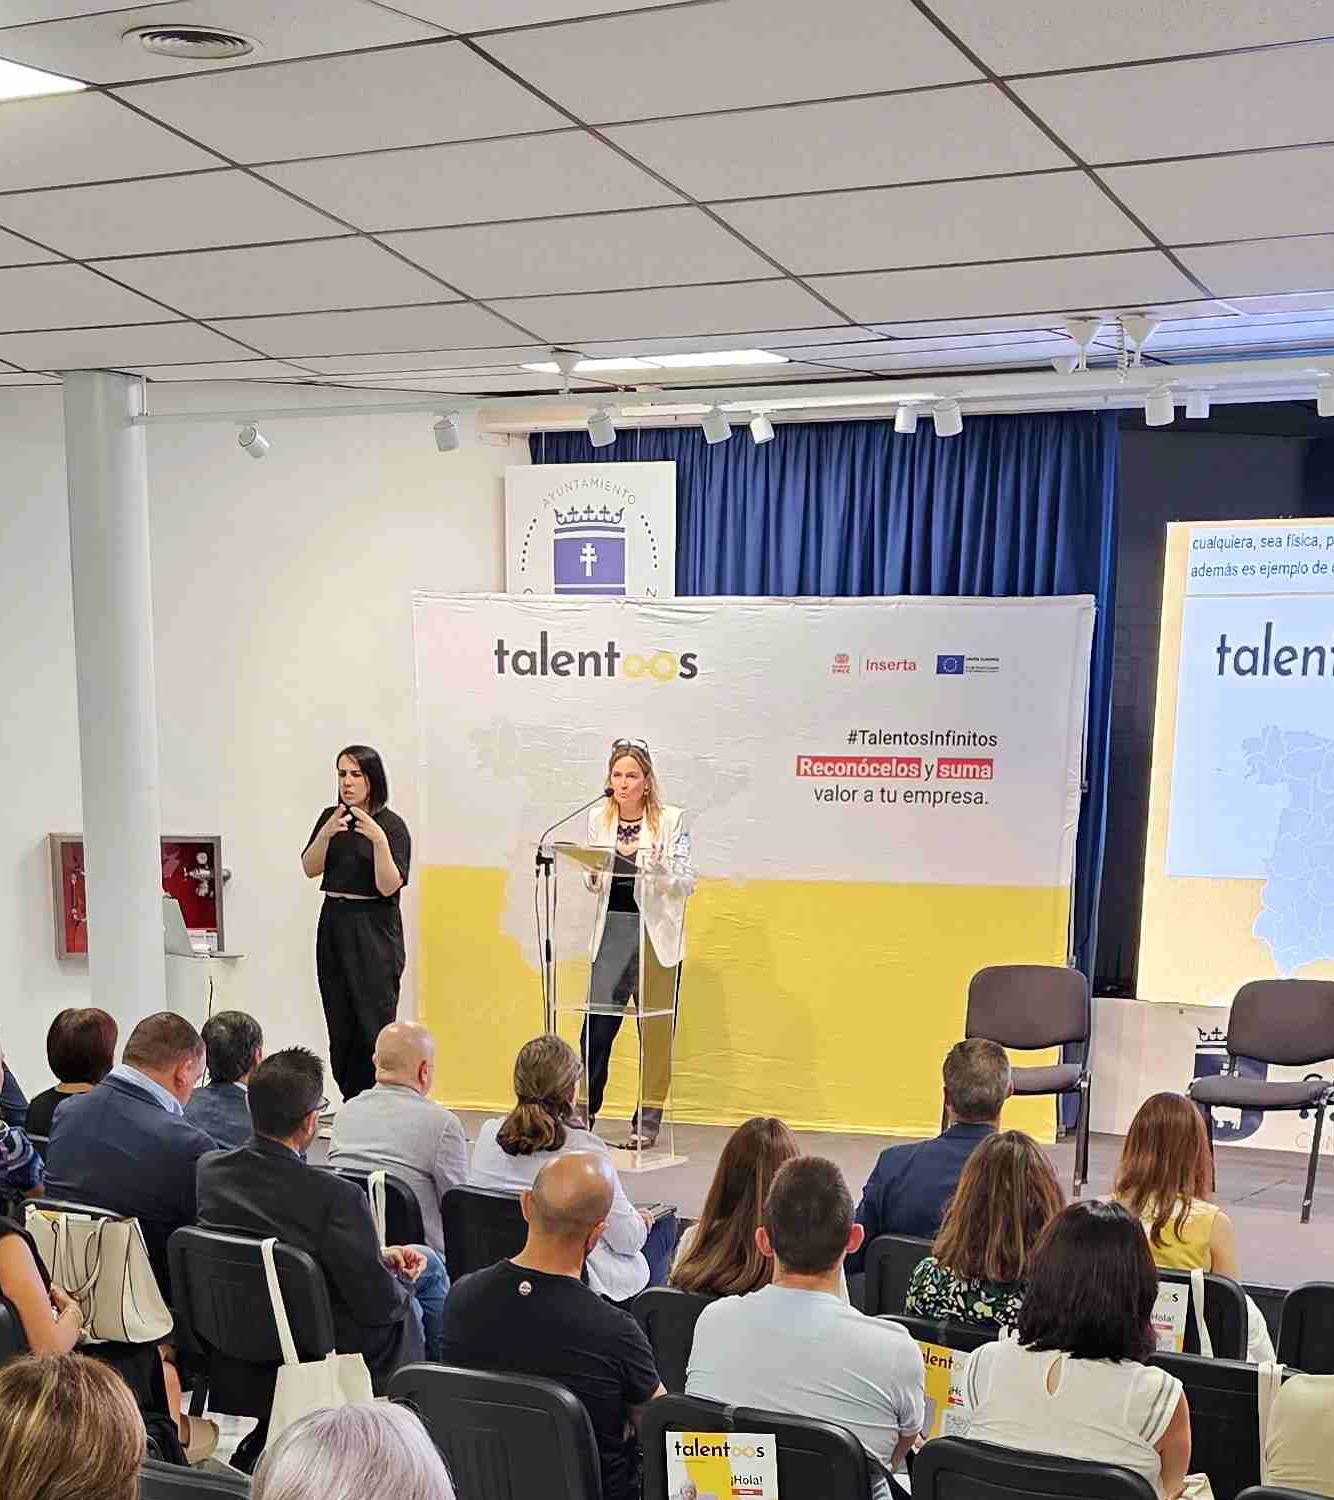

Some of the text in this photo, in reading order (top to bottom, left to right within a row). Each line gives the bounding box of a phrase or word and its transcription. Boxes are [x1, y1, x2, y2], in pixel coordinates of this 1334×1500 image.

[542, 478, 637, 508] AYUNTAMIENTO
[1192, 535, 1257, 552] cualquiera,
[1260, 536, 1282, 548] sea
[1286, 532, 1322, 550] física,
[1191, 559, 1238, 577] además
[1242, 564, 1255, 575] es
[1259, 559, 1308, 578] ejemplo
[1312, 560, 1328, 574] de
[866, 658, 917, 673] Inserta
[847, 729, 998, 747] #TalentosInfinitos
[799, 757, 992, 781] Reconócelos y suma
[814, 784, 989, 808] valor a tu empresa.
[730, 1475, 763, 1487] ¡Hola!
